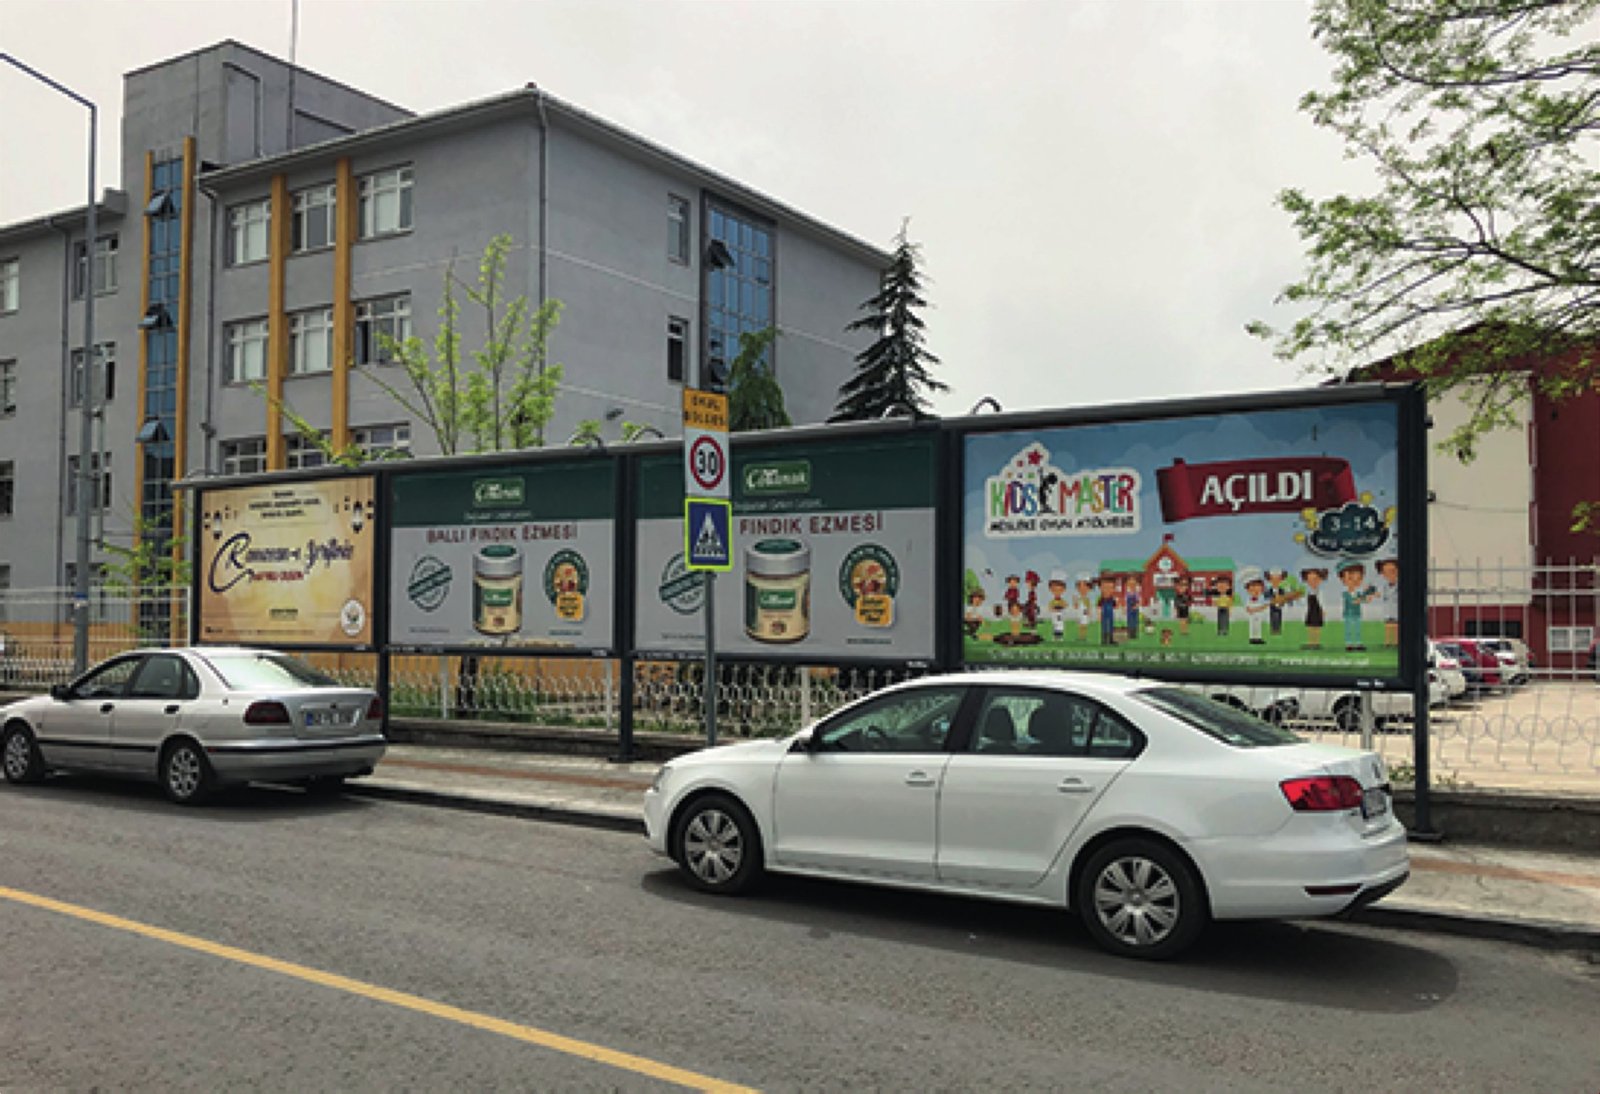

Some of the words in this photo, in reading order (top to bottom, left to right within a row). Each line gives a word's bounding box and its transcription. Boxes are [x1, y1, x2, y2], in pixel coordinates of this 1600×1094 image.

[697, 449, 717, 476] 30
[990, 480, 1038, 518] KIDS
[1058, 474, 1135, 515] MASTER
[1200, 469, 1312, 511] AÇILDI
[426, 529, 465, 544] BALLI
[469, 527, 517, 543] FINDIK
[739, 518, 802, 535] FINDIK
[808, 511, 883, 534] EZMESİ
